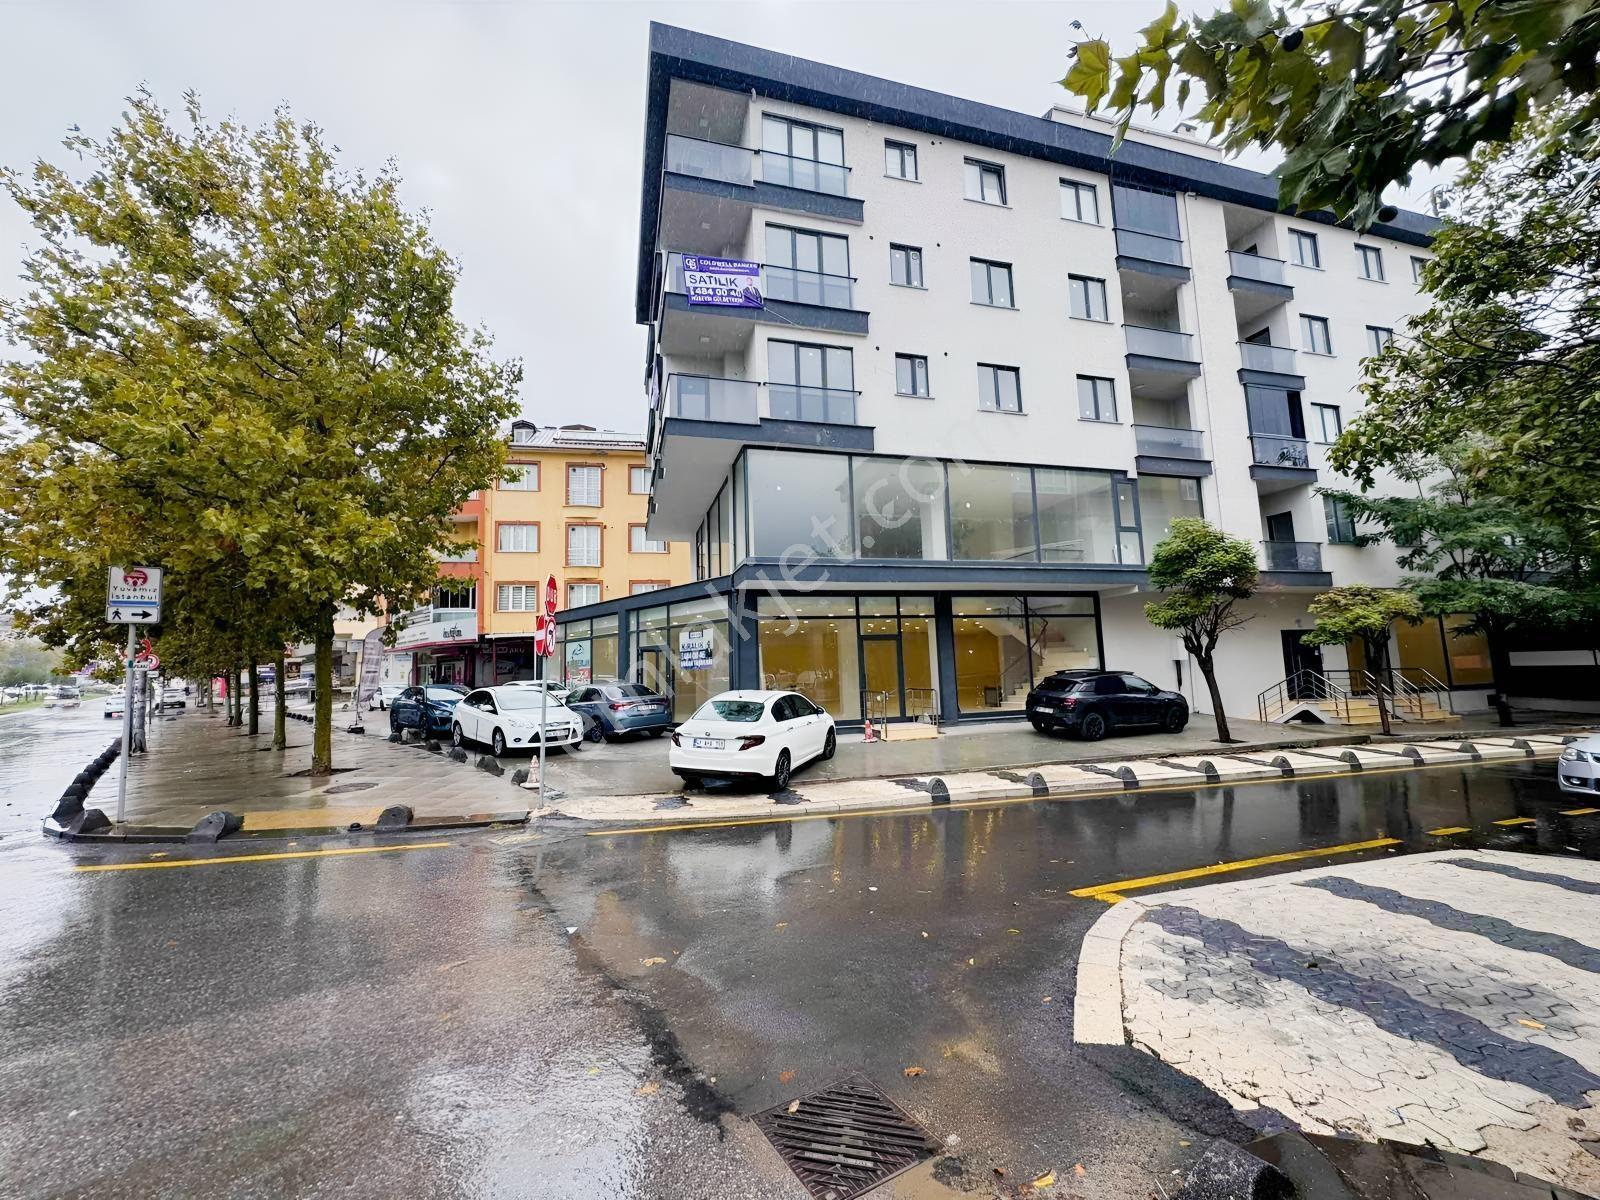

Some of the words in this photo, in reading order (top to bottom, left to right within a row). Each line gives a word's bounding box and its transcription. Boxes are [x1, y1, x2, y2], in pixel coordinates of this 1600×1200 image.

[689, 274, 739, 288] SATILIK
[695, 287, 713, 295] 484
[715, 288, 727, 296] 00
